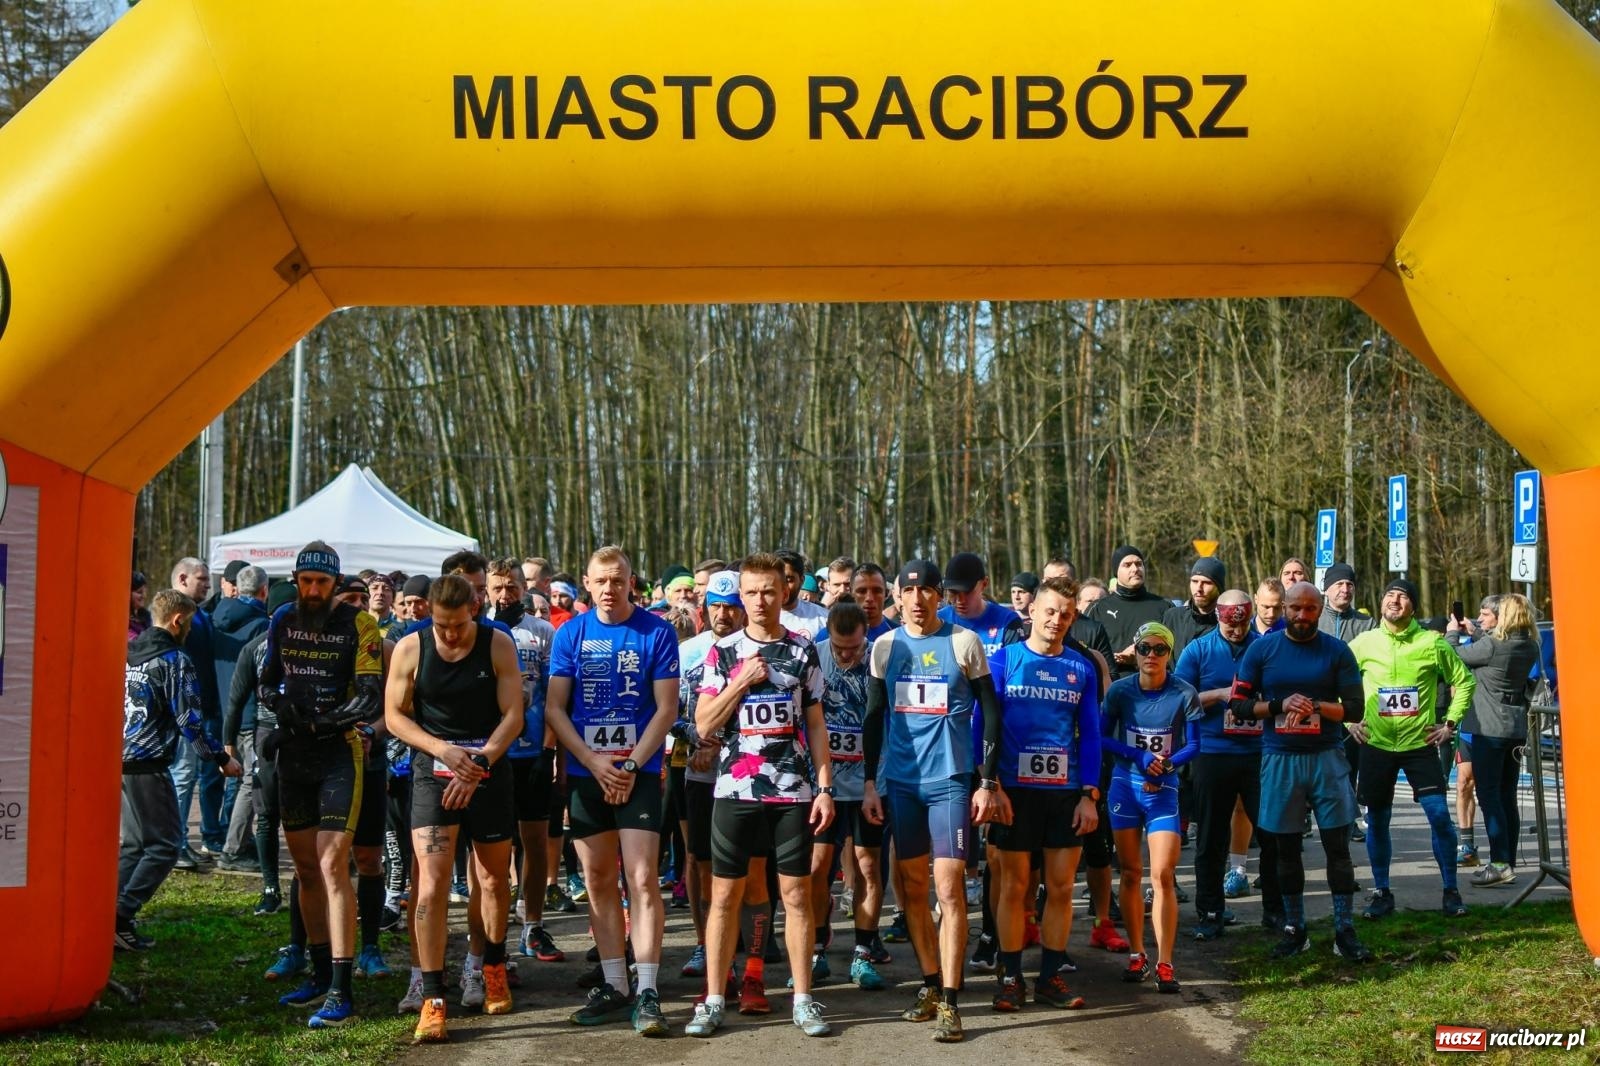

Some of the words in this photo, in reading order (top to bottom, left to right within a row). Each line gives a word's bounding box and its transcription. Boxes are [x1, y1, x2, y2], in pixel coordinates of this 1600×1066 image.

[453, 74, 777, 140] MIASTO
[808, 60, 1249, 141] RACIBÓRZ
[1392, 482, 1403, 521] P
[1520, 478, 1533, 523] P
[1320, 515, 1331, 550] P
[281, 648, 340, 660] CARBON
[917, 683, 926, 704] 1
[1386, 693, 1412, 710] 46
[744, 702, 789, 726] 105
[593, 725, 628, 747] 44
[829, 731, 857, 752] 83
[1135, 733, 1163, 753] 58
[1030, 754, 1060, 775] 66
[0, 824, 17, 840] E
